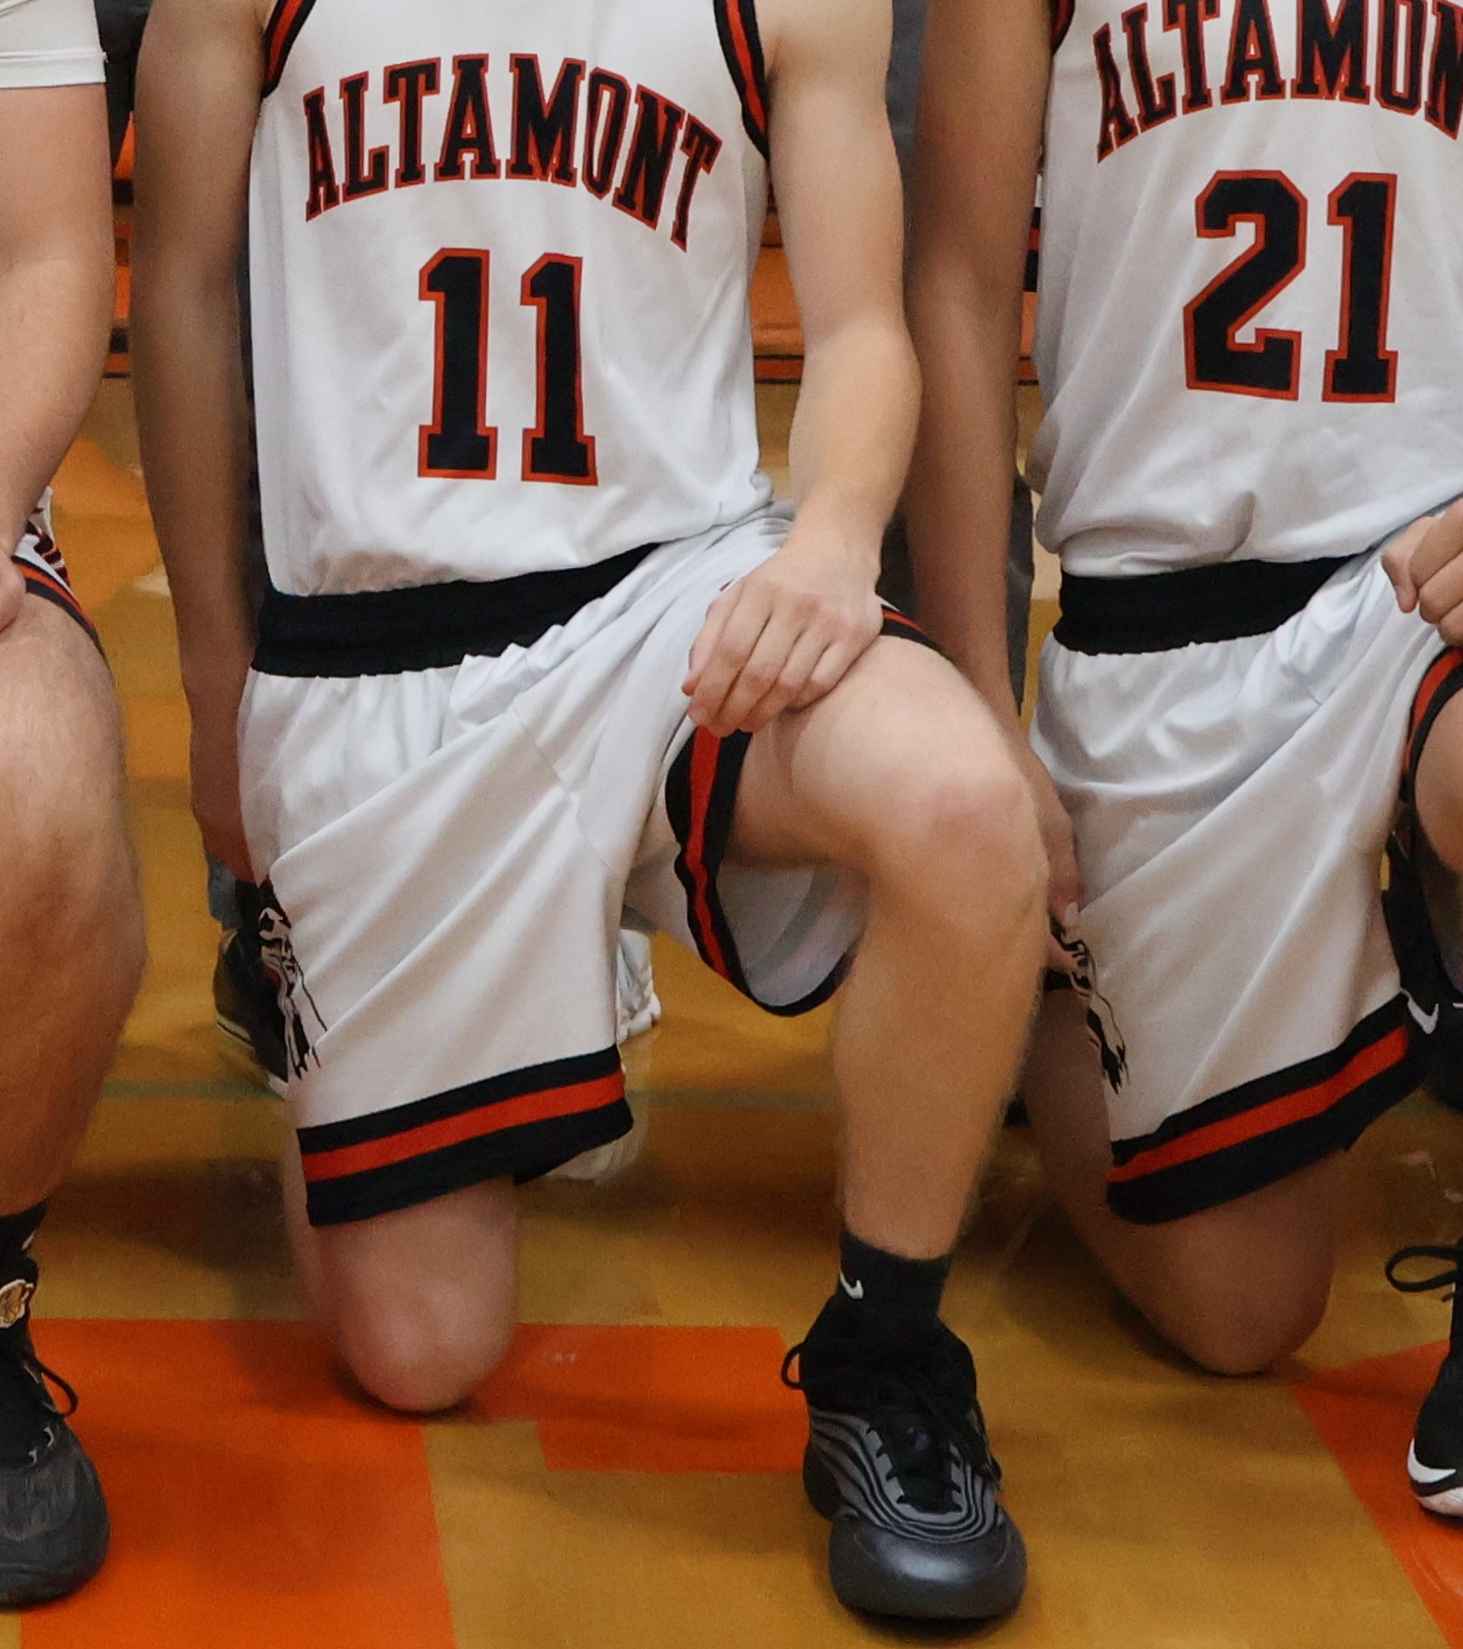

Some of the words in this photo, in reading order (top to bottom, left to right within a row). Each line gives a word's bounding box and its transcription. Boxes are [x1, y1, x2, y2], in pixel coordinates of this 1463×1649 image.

[303, 53, 723, 252] ALTAMONT
[418, 247, 598, 486] 11
[1183, 170, 1398, 403] 21
